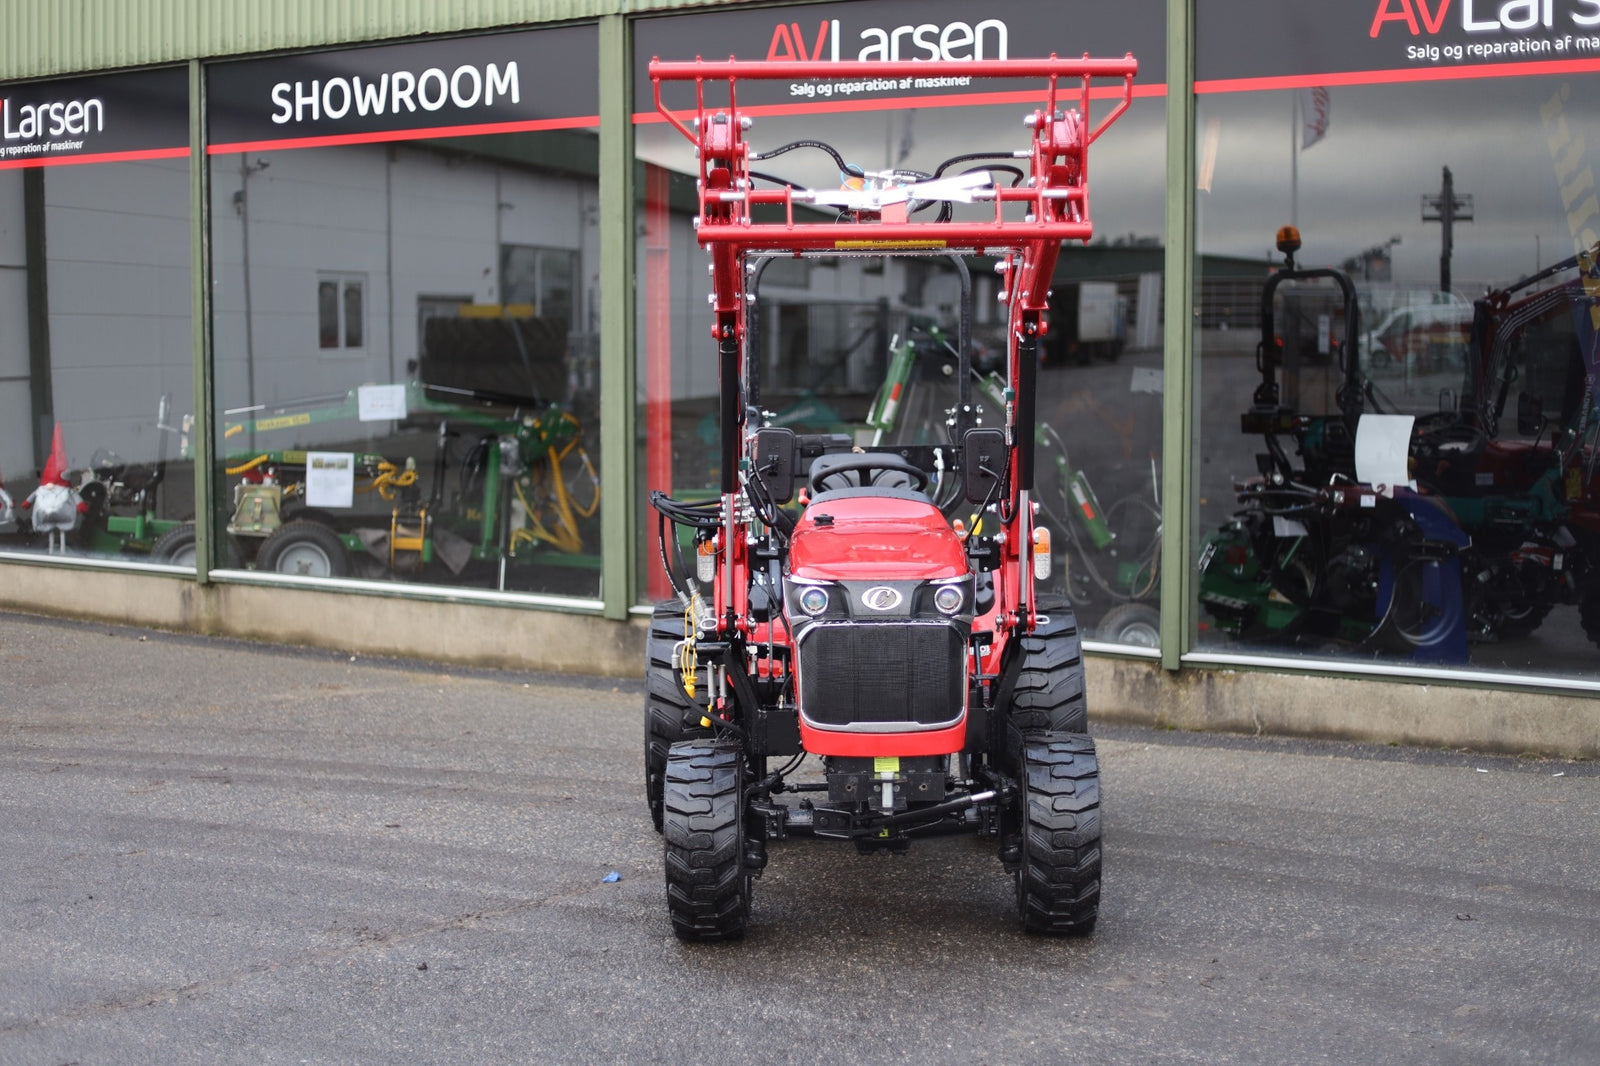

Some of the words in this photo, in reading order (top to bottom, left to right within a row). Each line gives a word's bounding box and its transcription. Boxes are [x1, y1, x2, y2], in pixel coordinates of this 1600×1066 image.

[1407, 44, 1440, 61] Salg
[1443, 45, 1463, 59] og
[1467, 38, 1551, 58] reparation
[1555, 35, 1572, 50] af
[1576, 37, 1600, 49] ma
[271, 61, 520, 124] SHOWROOM
[790, 83, 815, 97] Salg
[817, 83, 832, 96] og
[834, 78, 897, 95] reparation
[899, 76, 913, 89] af
[915, 76, 972, 88] maskiner
[0, 98, 103, 139] Larsen
[6, 143, 41, 155] reparation
[42, 142, 50, 151] af
[51, 141, 83, 149] maskiner
